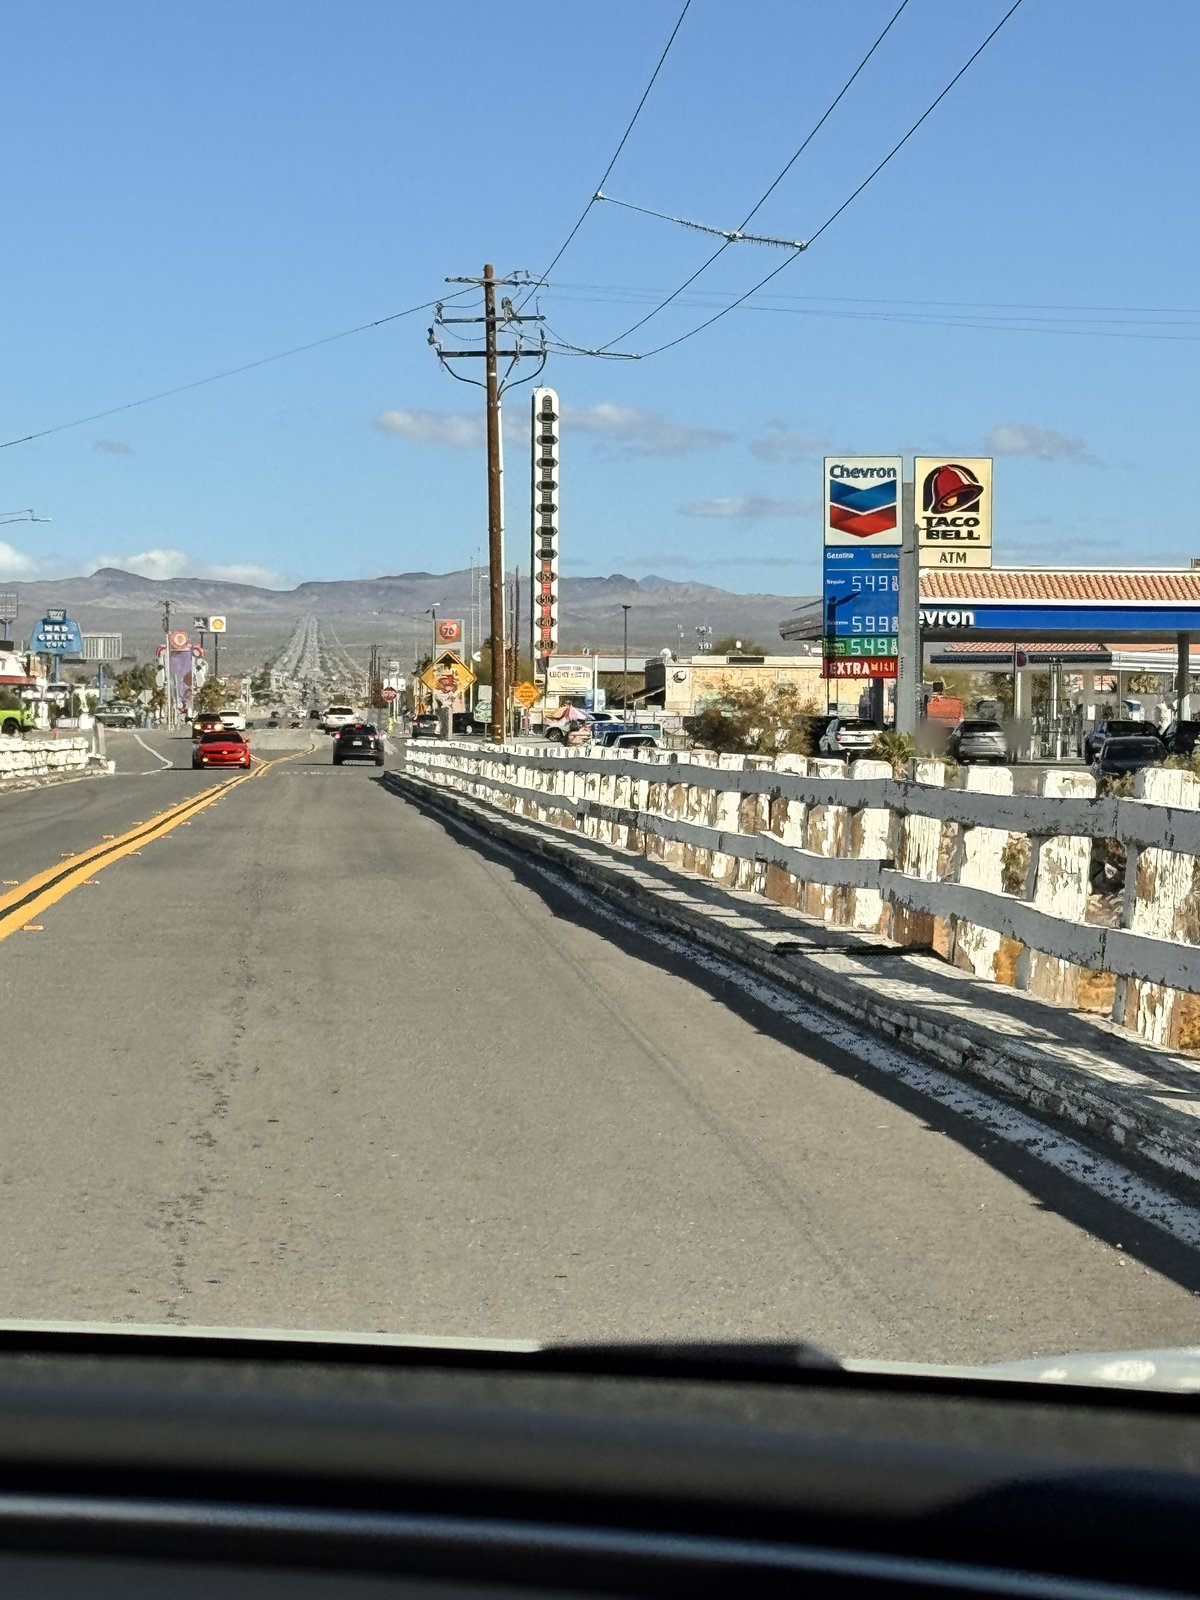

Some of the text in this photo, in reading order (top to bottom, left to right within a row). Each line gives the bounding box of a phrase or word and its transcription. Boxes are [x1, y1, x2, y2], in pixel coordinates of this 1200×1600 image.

[830, 464, 897, 479] Chevron
[922, 516, 980, 528] TACO
[926, 529, 980, 541] BELL
[939, 552, 967, 564] ATM
[44, 624, 69, 633] MAD
[443, 627, 455, 636] 76
